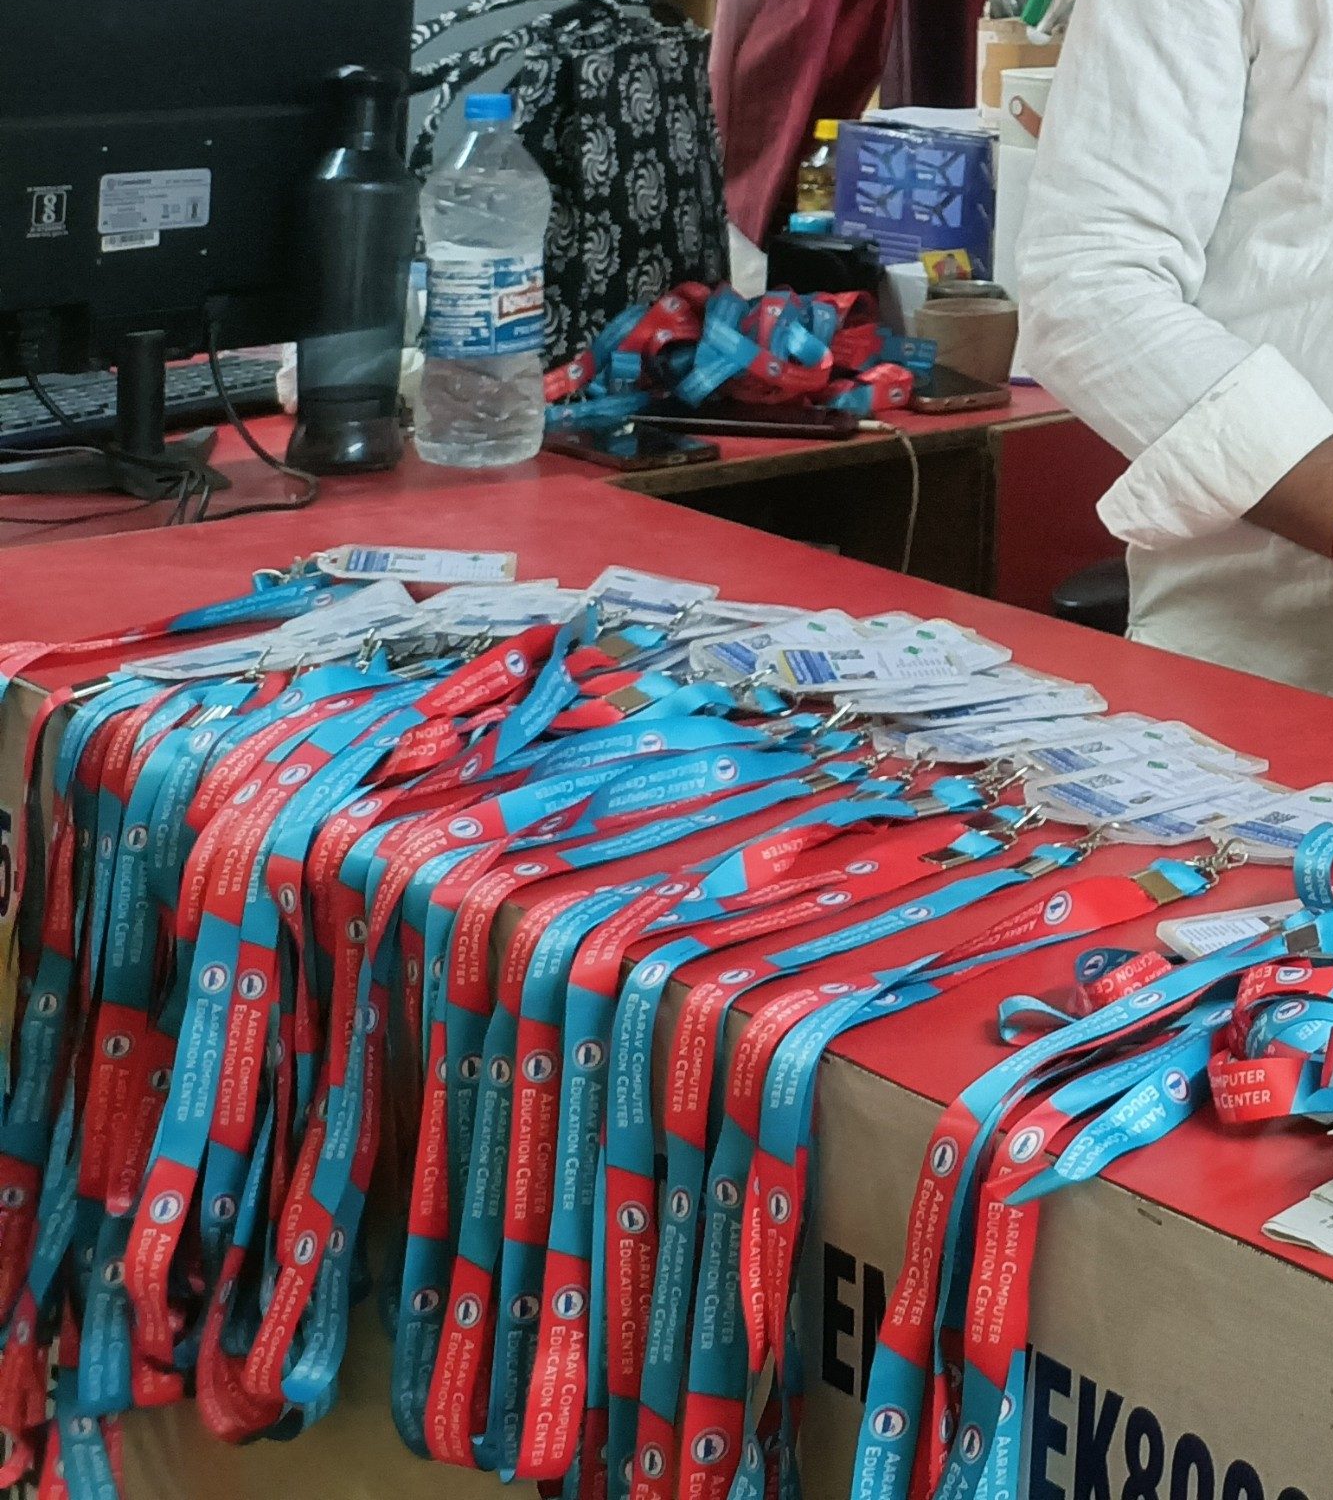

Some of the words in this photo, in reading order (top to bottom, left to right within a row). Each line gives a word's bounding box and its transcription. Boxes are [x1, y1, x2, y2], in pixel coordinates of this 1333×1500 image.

[187, 997, 211, 1072] EDUCATION
[207, 1002, 220, 1047] AARAV
[618, 992, 641, 1074] EDUCATION
[634, 999, 652, 1051] AARAV
[176, 1070, 198, 1123] CENTER
[193, 1049, 217, 1119] COMPUTER
[616, 1073, 631, 1129] CENTER
[632, 1051, 648, 1125] COMPUTER
[1211, 1068, 1266, 1088] OMPUTER
[982, 1201, 1005, 1286] EDUCATION
[1003, 1207, 1025, 1258] AARAV
[971, 1285, 994, 1345] CENTER
[987, 1259, 1018, 1345] COMPUTER
[440, 1331, 461, 1408] EDUCATION
[460, 1338, 475, 1389] AARAV
[540, 1325, 567, 1412] EDUCATION
[564, 1329, 585, 1383] AARAV
[434, 1406, 449, 1458] CENTER
[450, 1388, 465, 1459] COMPUTER
[530, 1410, 554, 1468] CENTER
[550, 1381, 578, 1460] COMPUTER
